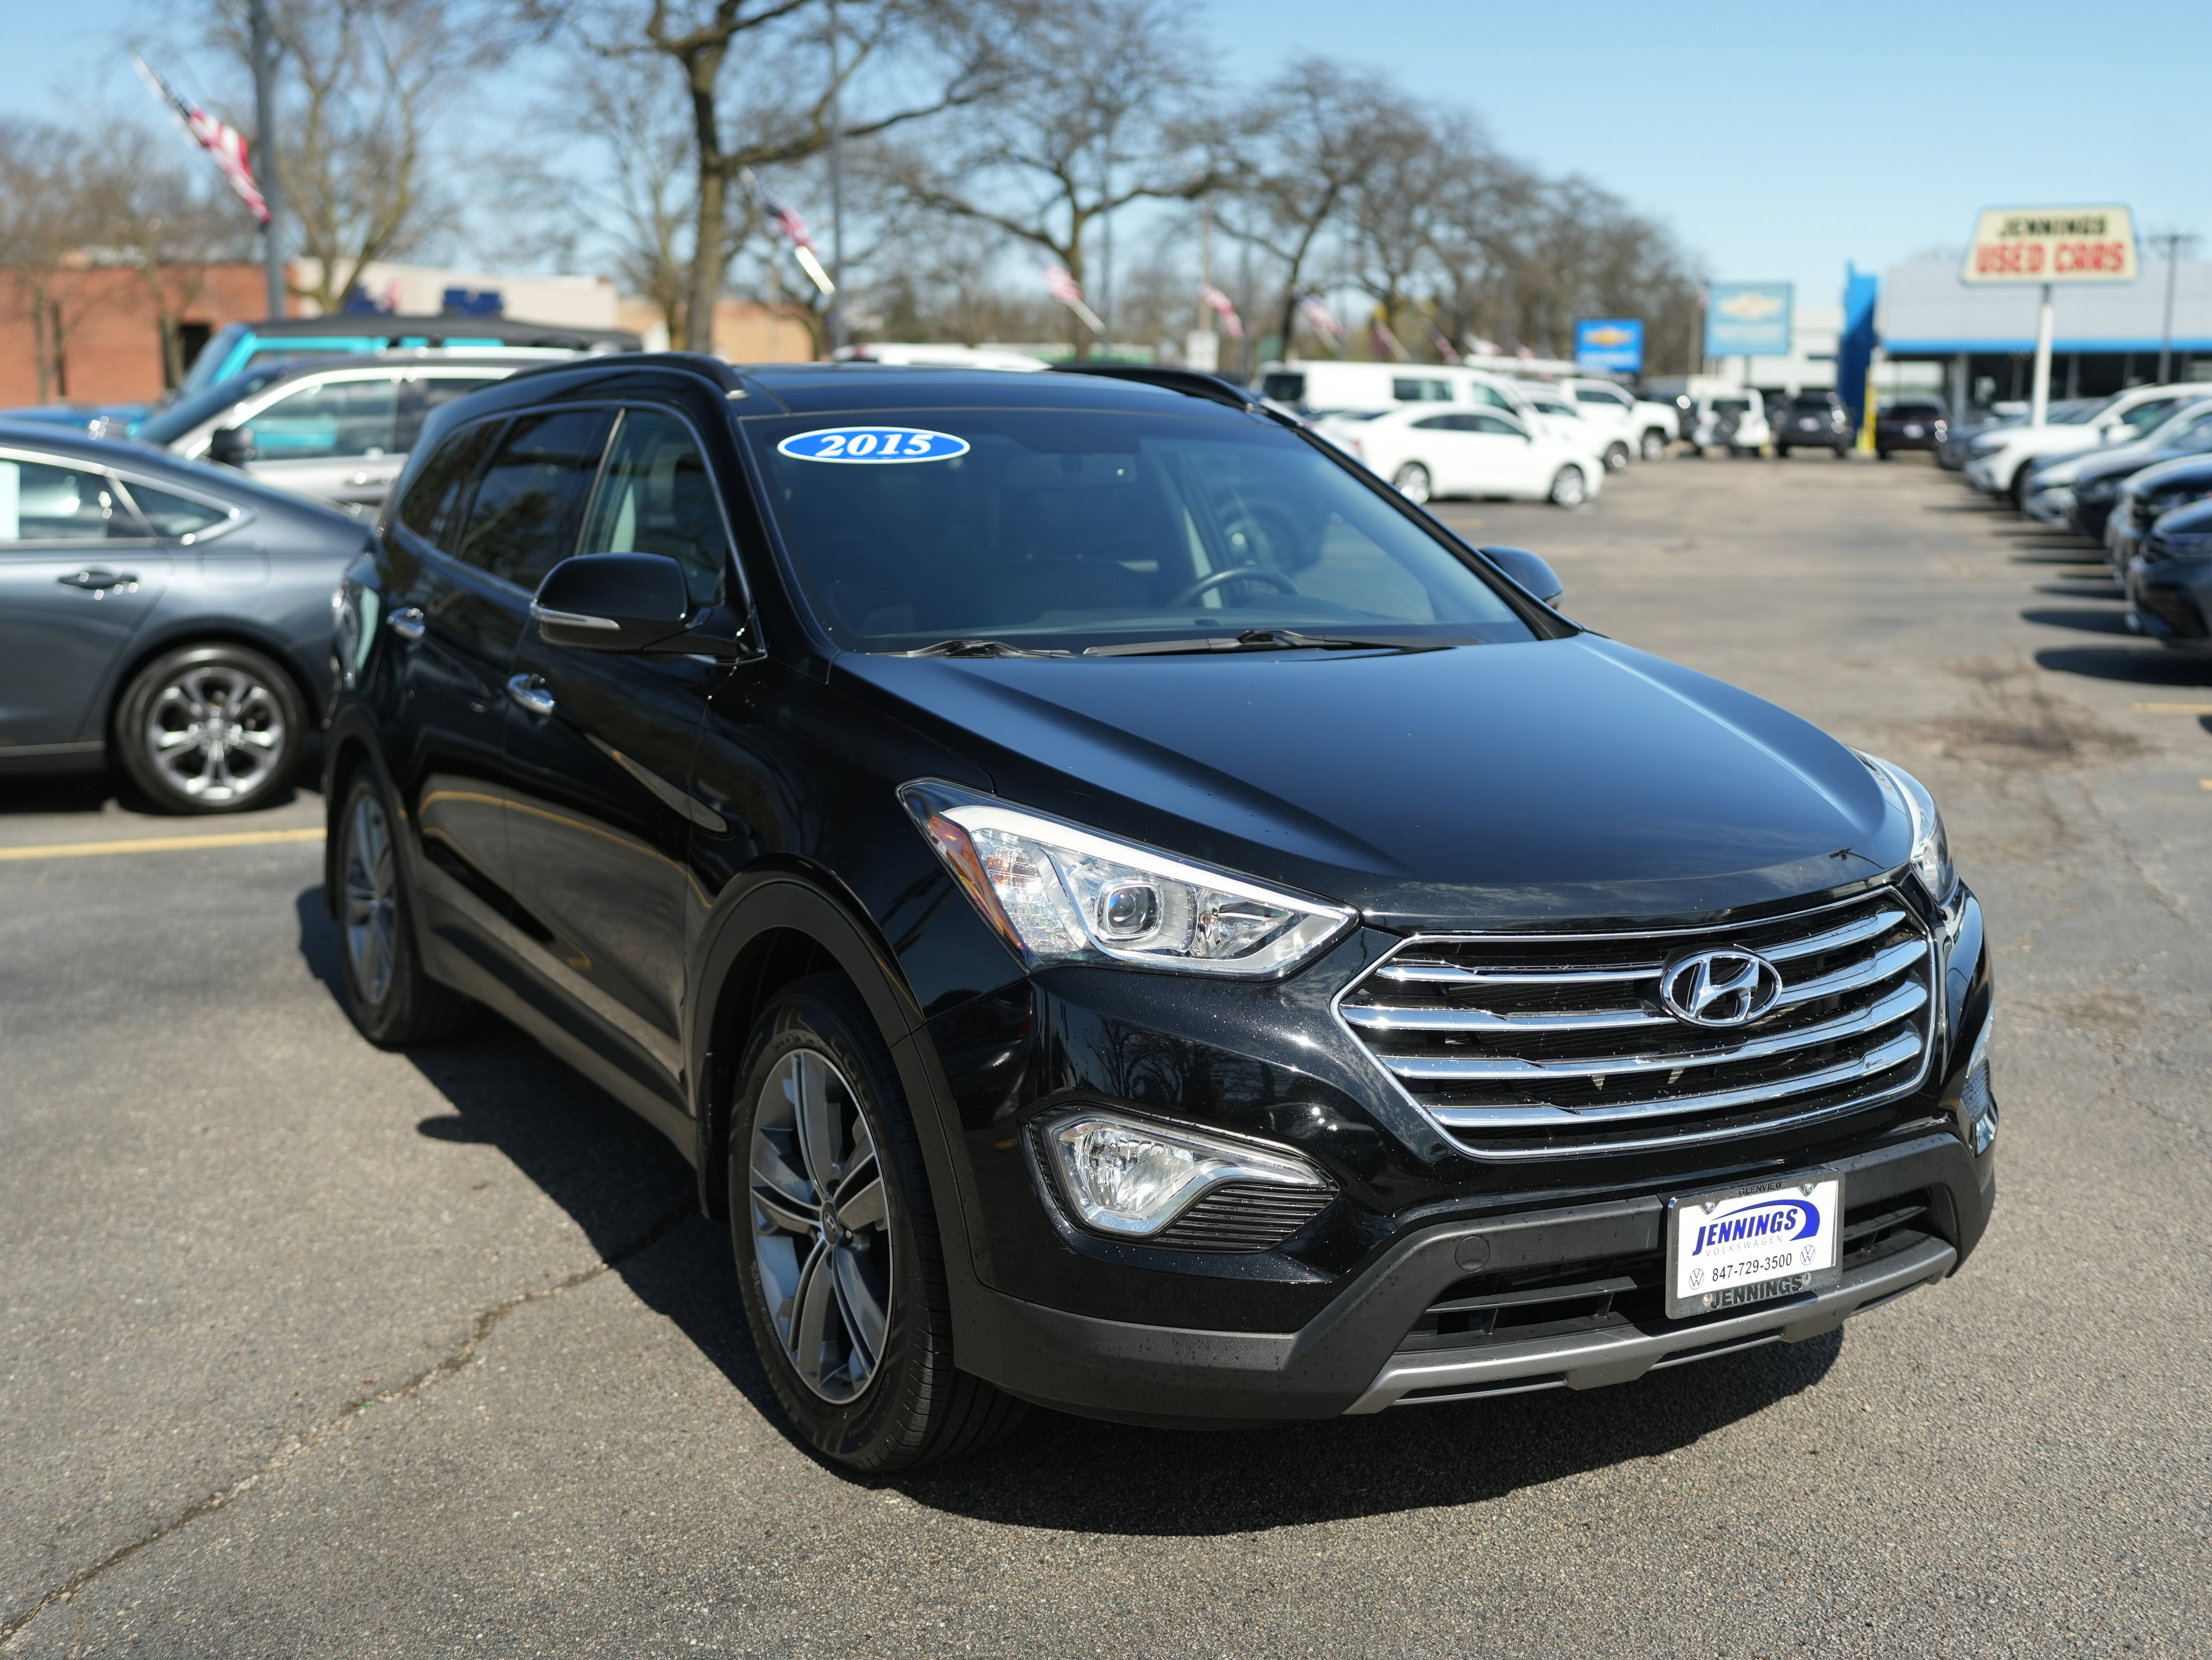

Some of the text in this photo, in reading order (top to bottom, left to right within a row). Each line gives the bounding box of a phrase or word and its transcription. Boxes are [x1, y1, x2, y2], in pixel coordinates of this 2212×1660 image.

[1997, 215, 2108, 237] JENNINGS
[1977, 242, 2126, 273] USED CARS
[815, 433, 934, 456] 2015
[1739, 1181, 1782, 1195] GLENVIEW
[1693, 1208, 1798, 1256] JENNINGS
[1706, 1235, 1782, 1256] VOLKSWAGEN
[1712, 1253, 1792, 1282] 847-729-3500
[1711, 1275, 1802, 1308] JENNINGS
